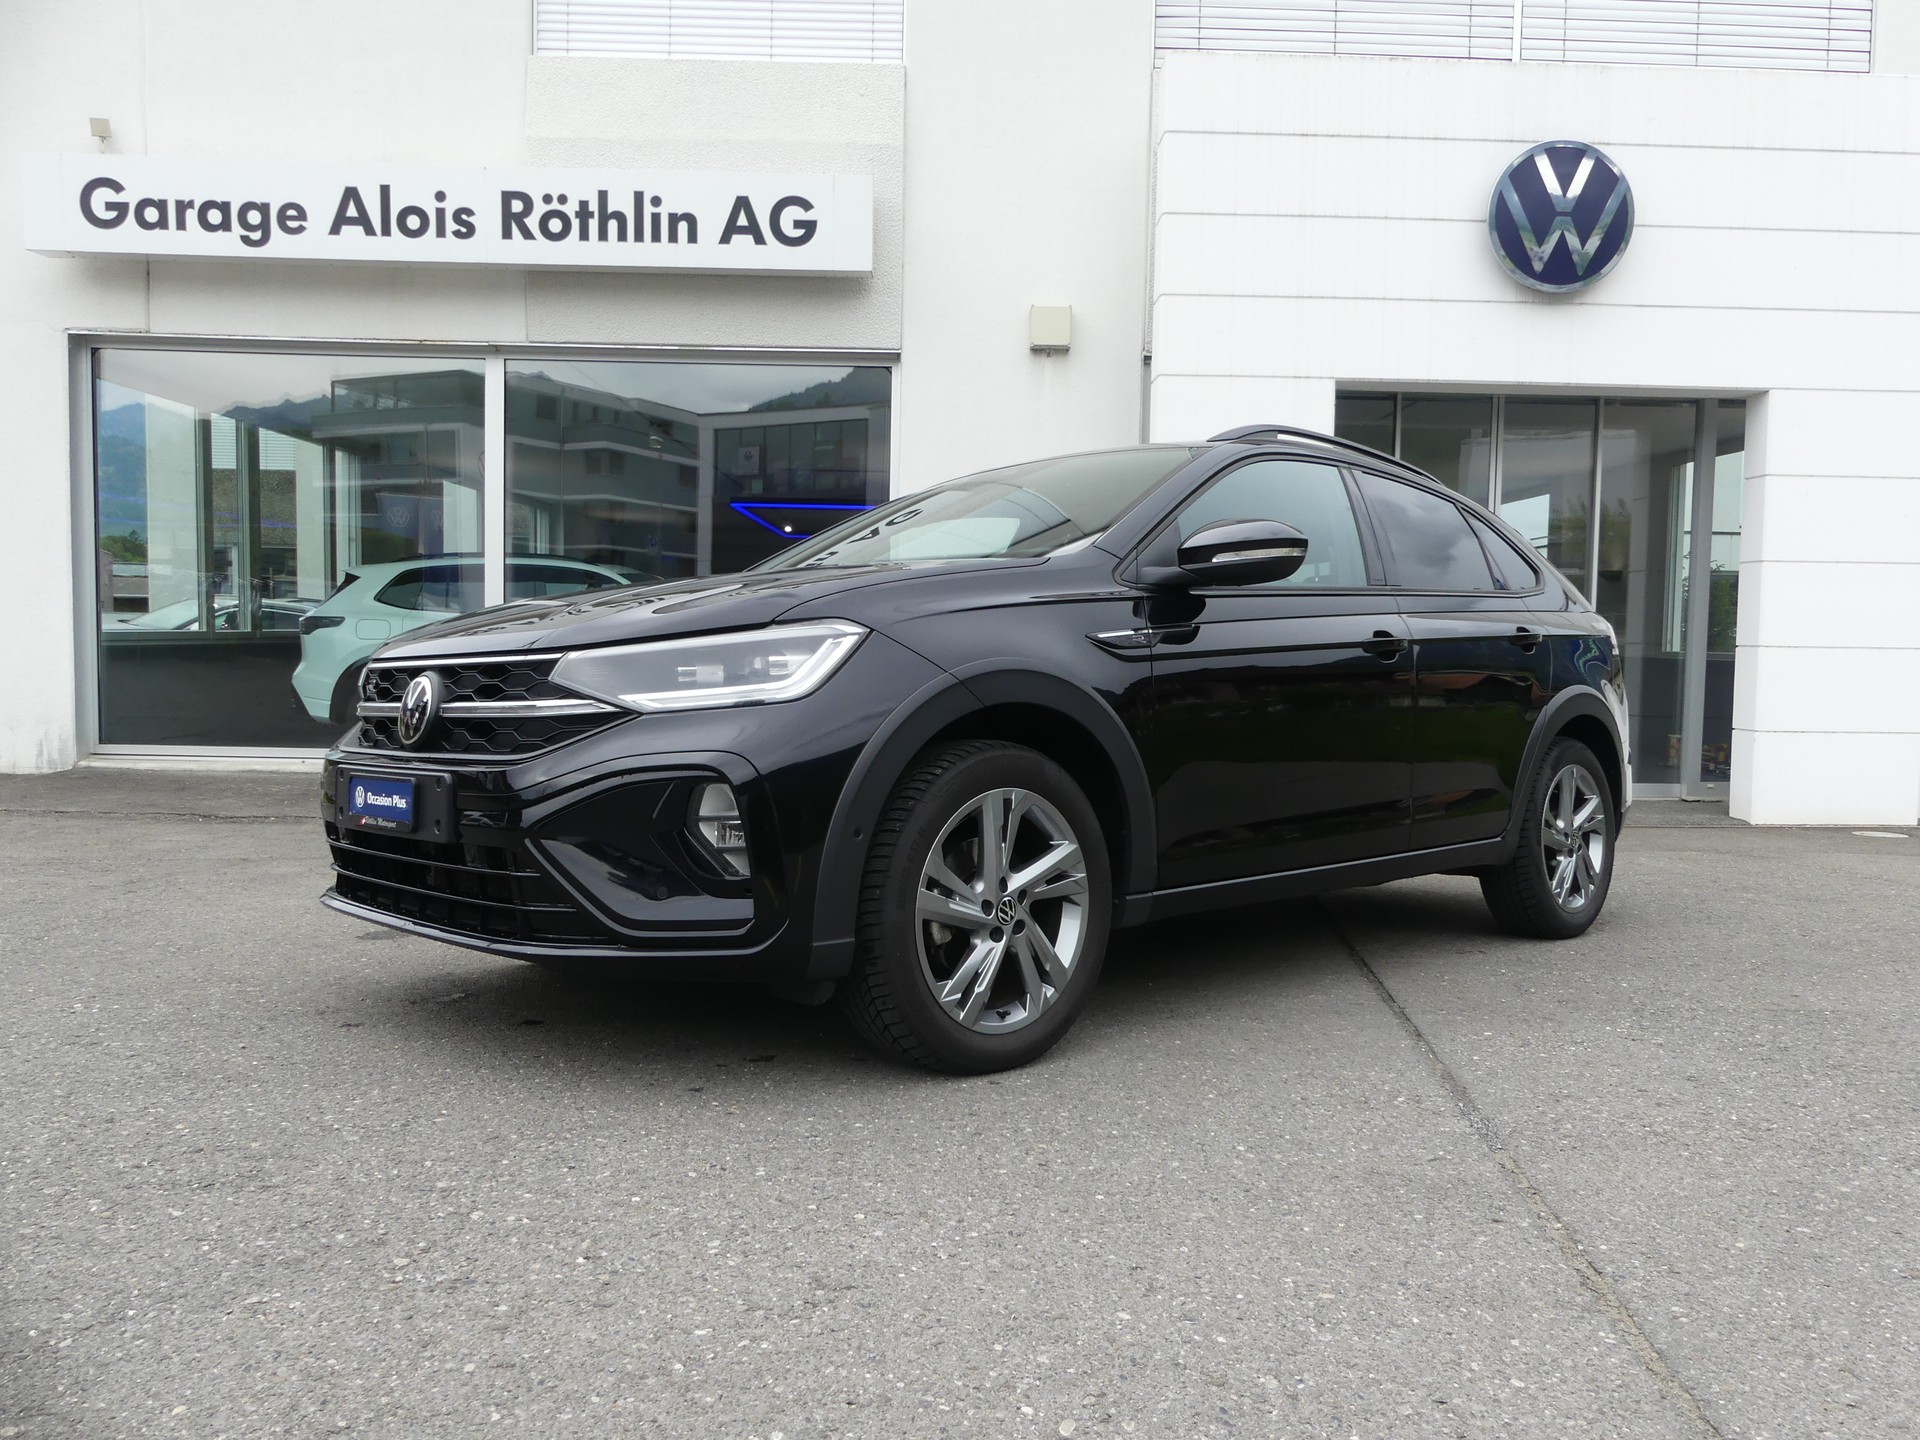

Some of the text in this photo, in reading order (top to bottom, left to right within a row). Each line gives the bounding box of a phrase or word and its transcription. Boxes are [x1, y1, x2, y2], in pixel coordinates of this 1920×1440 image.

[80, 177, 818, 248] Garage Alois Röthlin AG
[367, 792, 392, 807] Occasion
[392, 794, 407, 809] Plus
